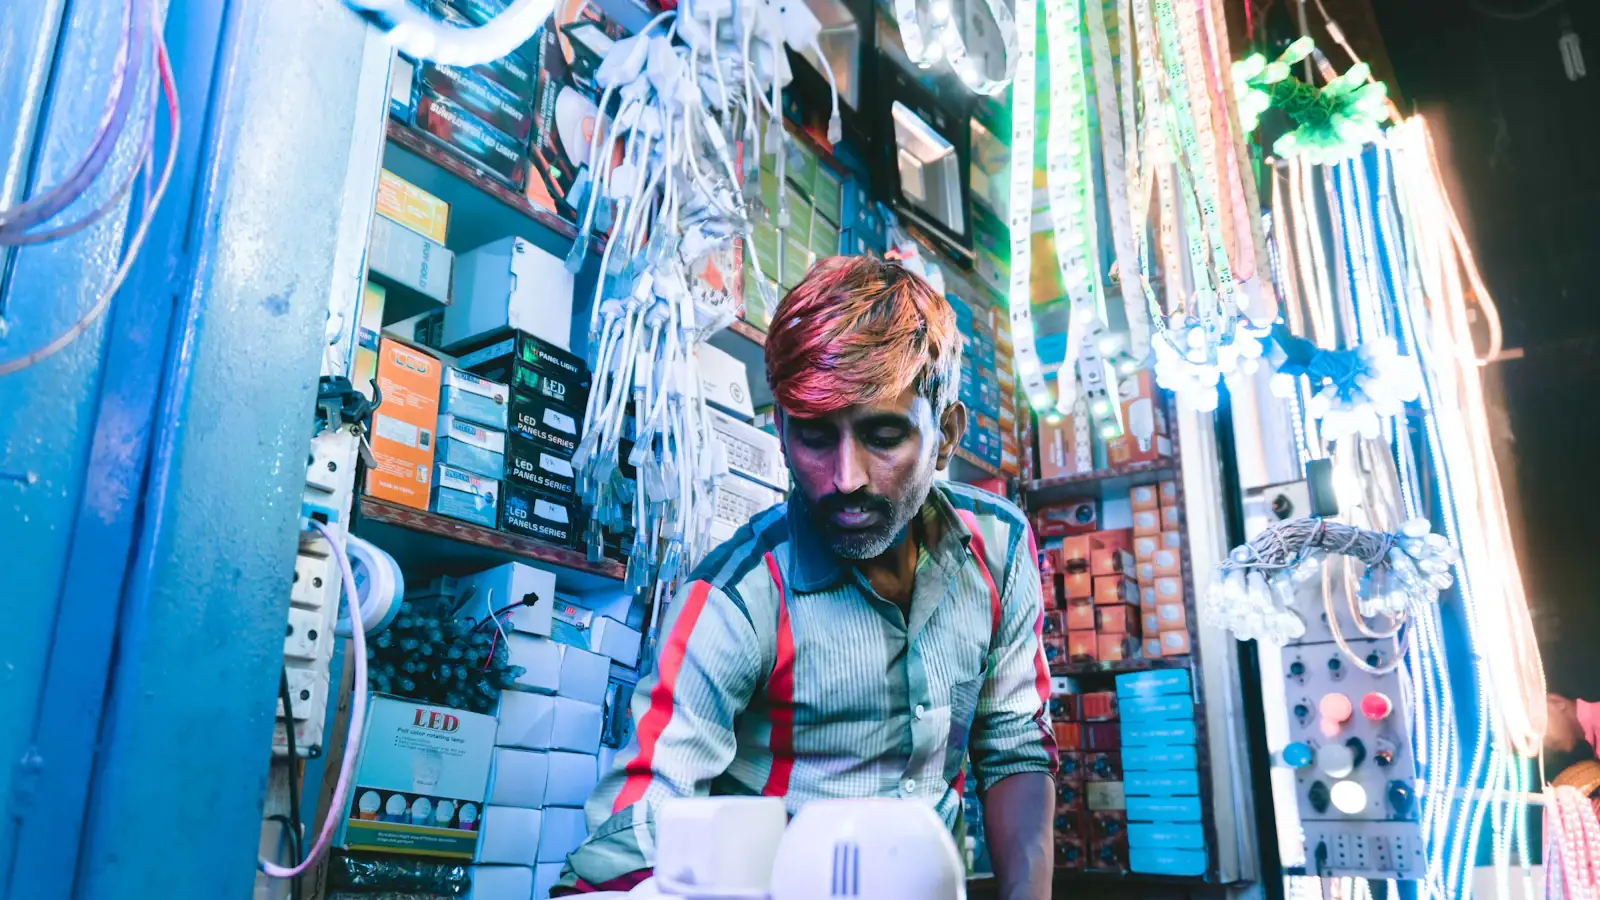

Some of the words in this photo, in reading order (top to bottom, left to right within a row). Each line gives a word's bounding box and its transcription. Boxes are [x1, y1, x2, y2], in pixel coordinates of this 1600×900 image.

[500, 101, 524, 121] LIGHT
[429, 102, 481, 138] SUNFLOWER
[480, 132, 496, 147] LED
[495, 142, 519, 162] LIGHT
[538, 350, 560, 366] PANEL
[560, 361, 578, 373] LIGHT
[542, 376, 566, 396] LED
[518, 412, 536, 427] LED
[517, 422, 547, 440] PANELS
[547, 434, 574, 449] SERIES
[515, 458, 533, 472] LED
[513, 468, 544, 485] PANELS
[543, 478, 572, 493] SERIES
[509, 506, 527, 519] LED
[508, 516, 538, 532] PANELS
[538, 525, 567, 539] SERIES
[412, 708, 460, 733] LED
[426, 731, 450, 742] rotating
